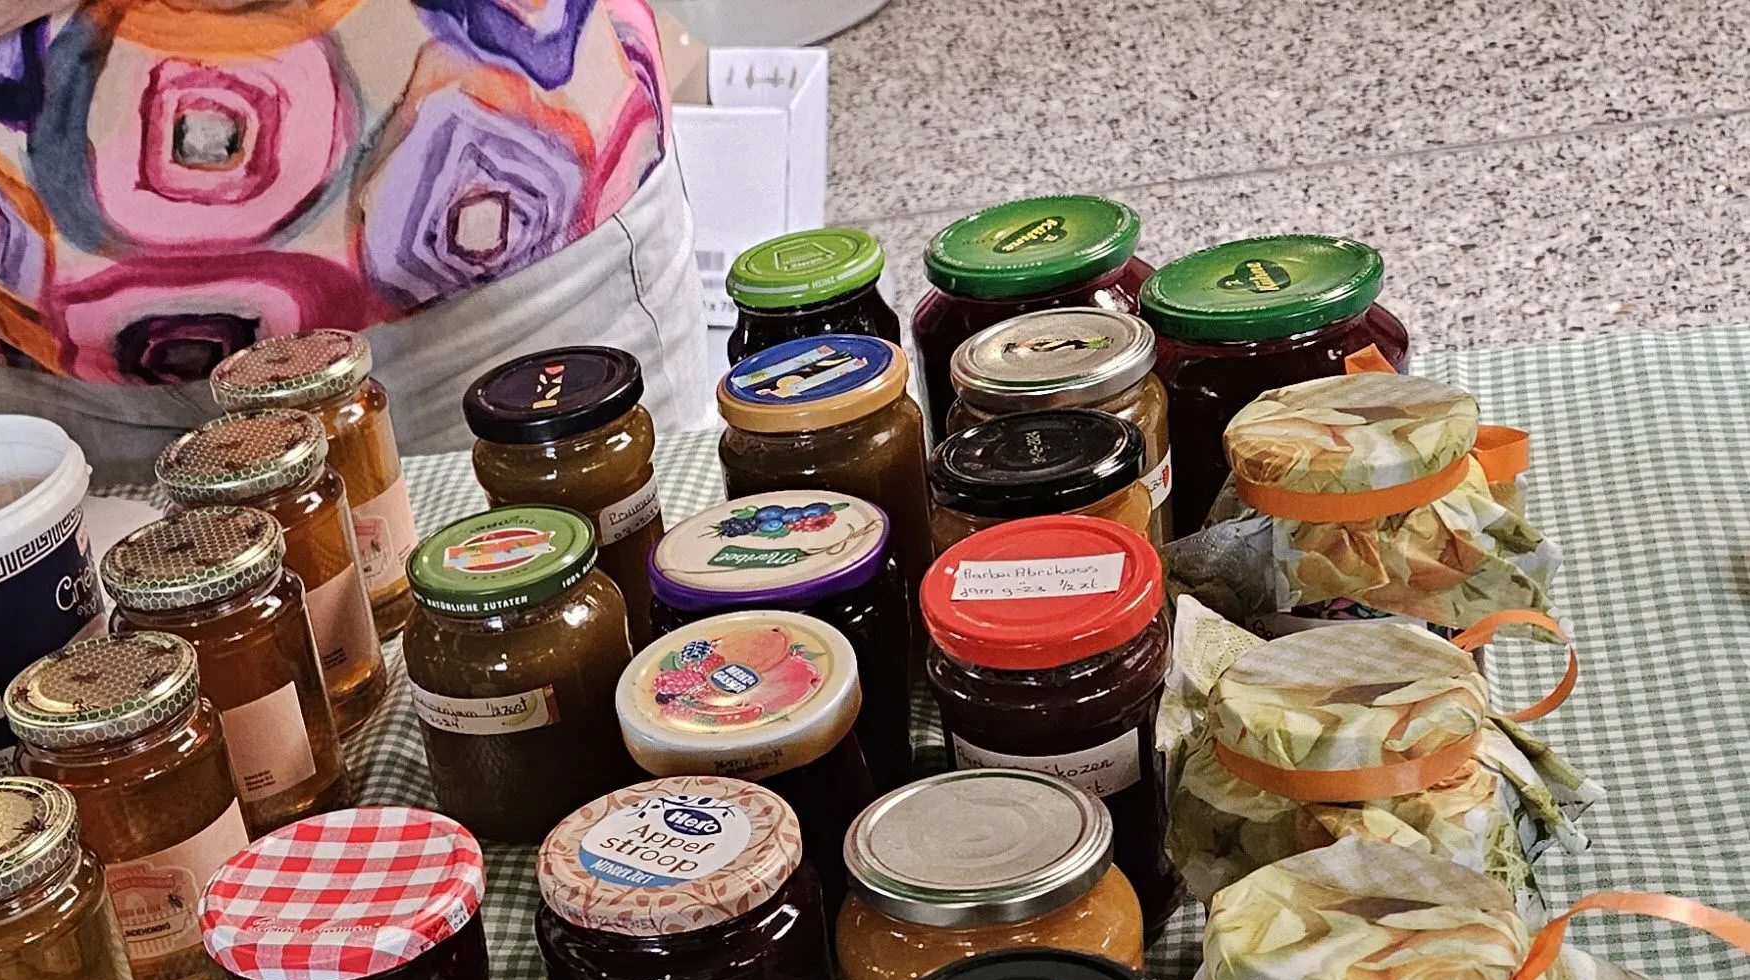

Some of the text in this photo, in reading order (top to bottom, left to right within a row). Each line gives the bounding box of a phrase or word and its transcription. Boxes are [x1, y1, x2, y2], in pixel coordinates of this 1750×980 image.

[666, 810, 719, 832] Hero
[599, 837, 699, 873] stroop
[627, 823, 715, 855] Appel
